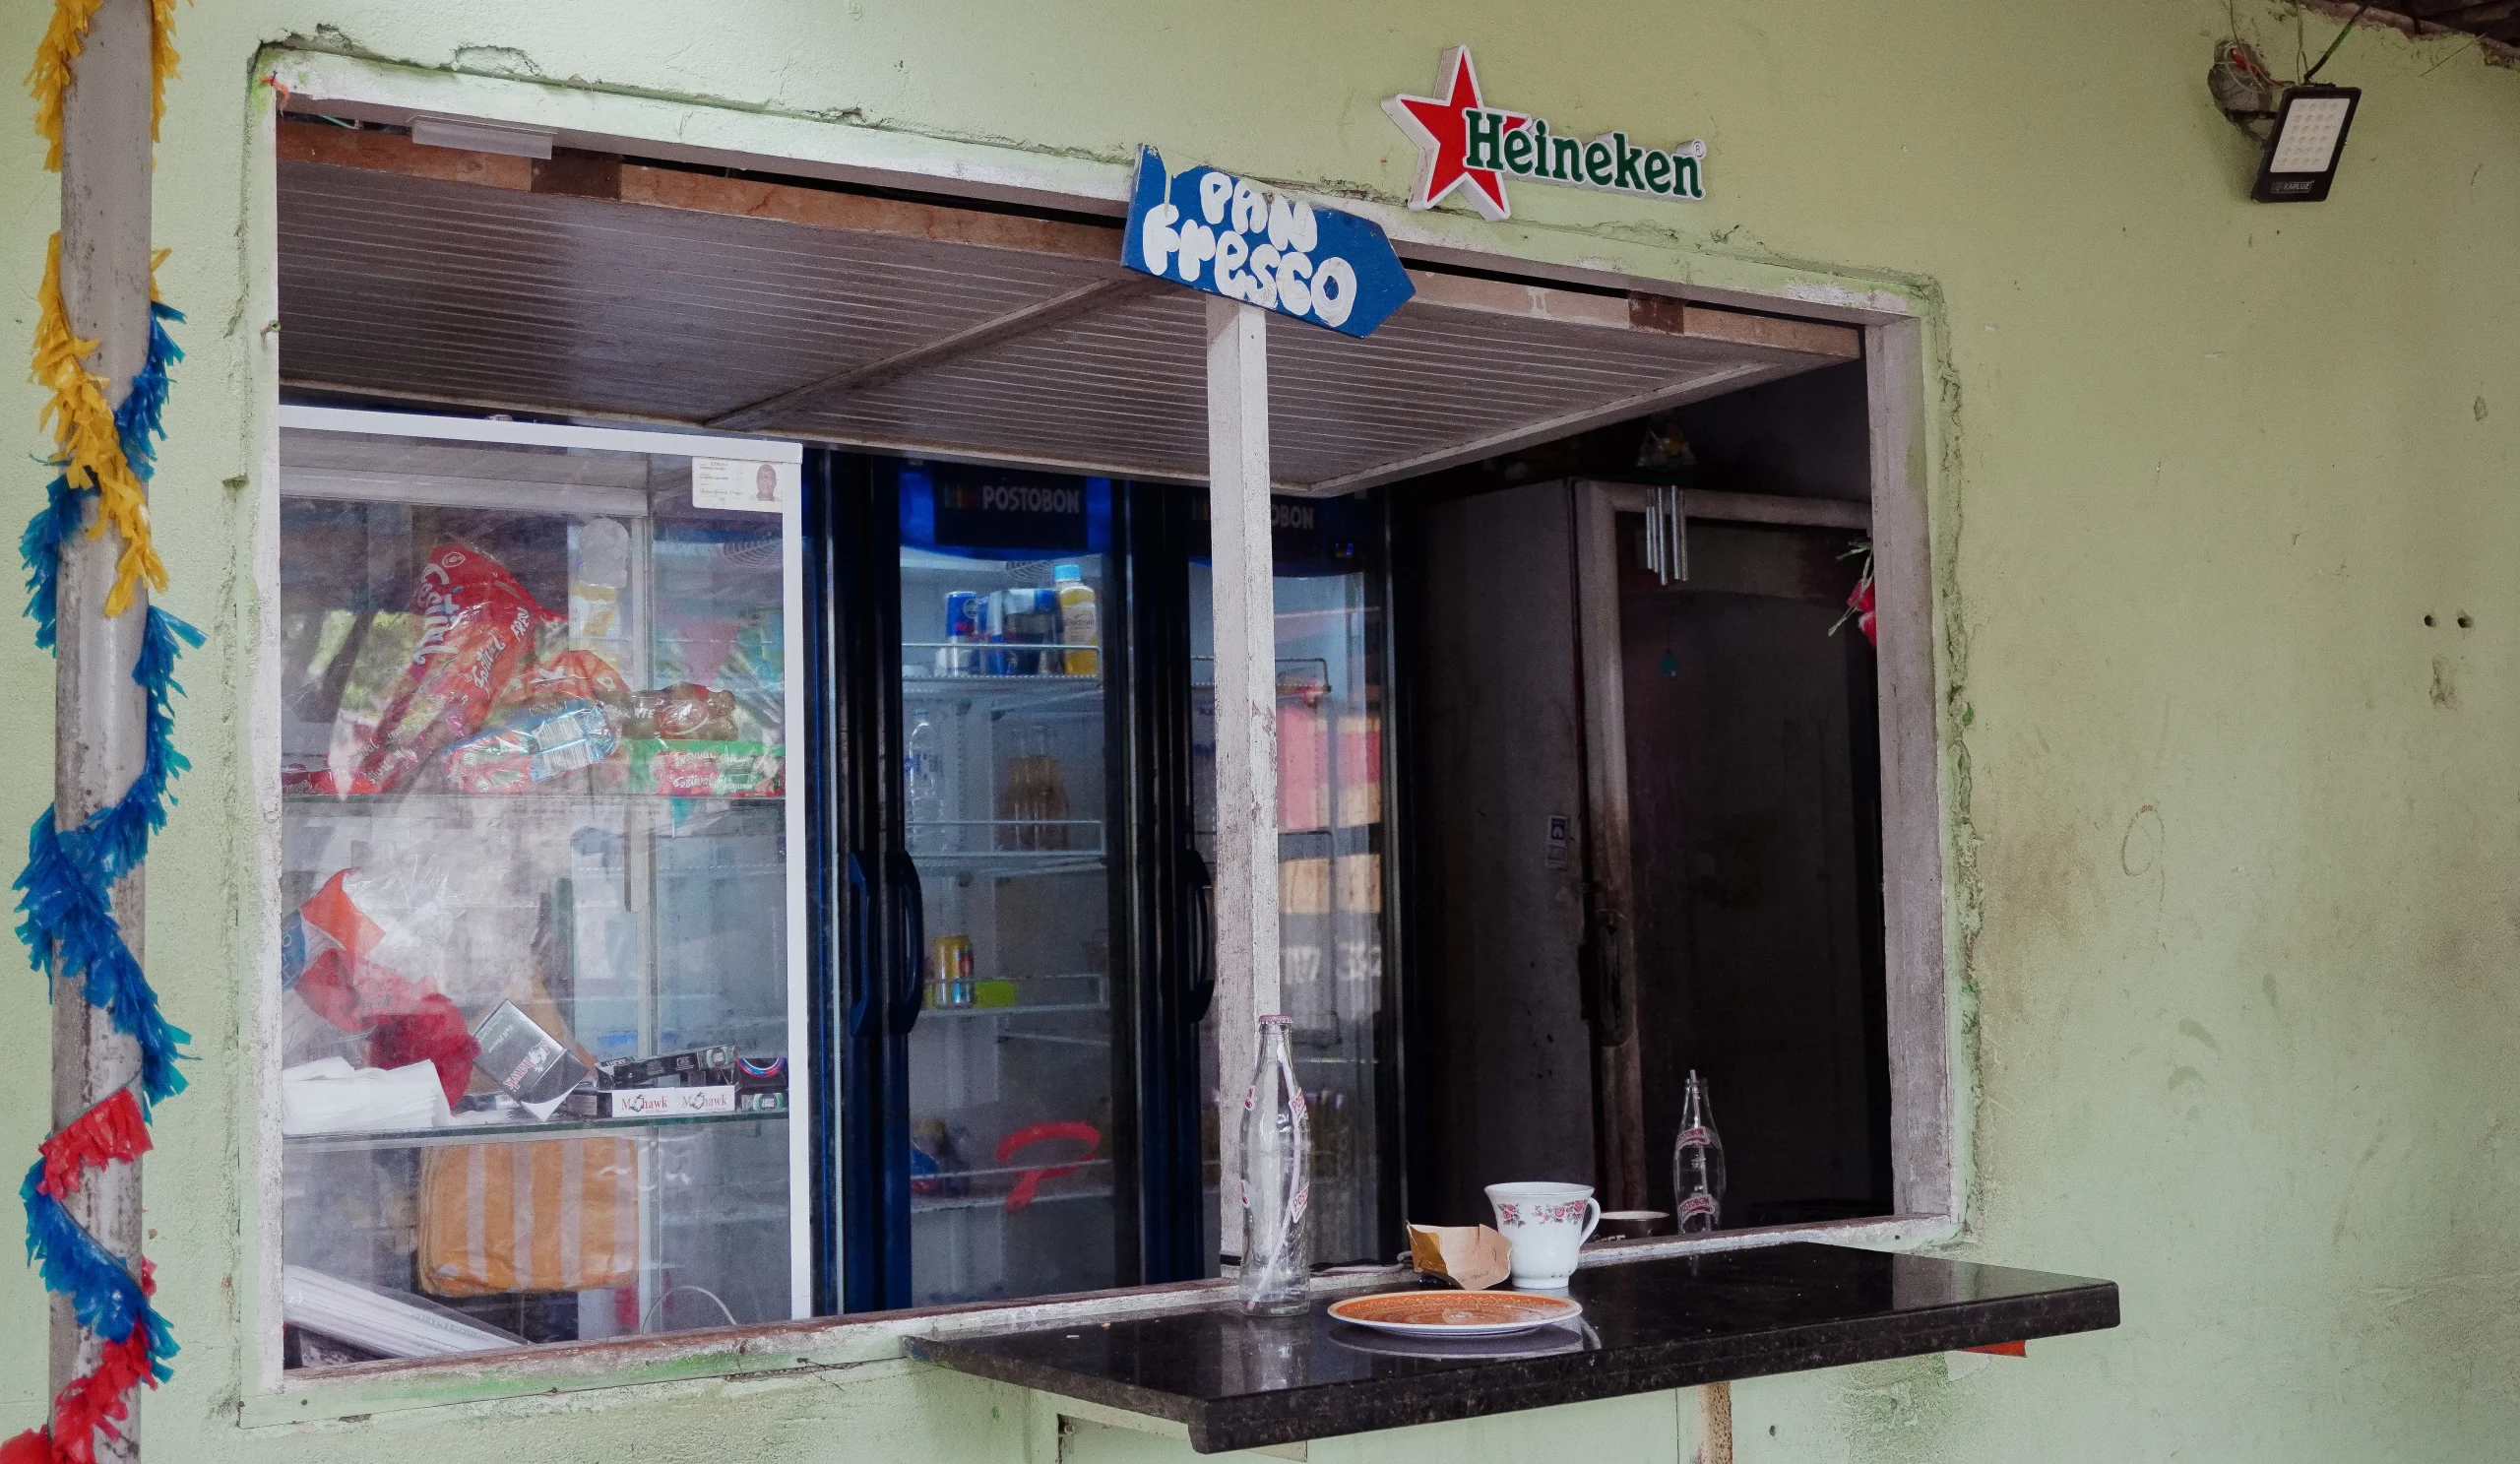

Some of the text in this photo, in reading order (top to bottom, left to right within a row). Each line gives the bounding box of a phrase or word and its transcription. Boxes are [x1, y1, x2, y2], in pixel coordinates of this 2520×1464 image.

[1463, 108, 1704, 199] Heineken
[1199, 170, 1318, 253] PAN
[981, 485, 1081, 514] POSTOBON
[1270, 505, 1315, 529] OBON
